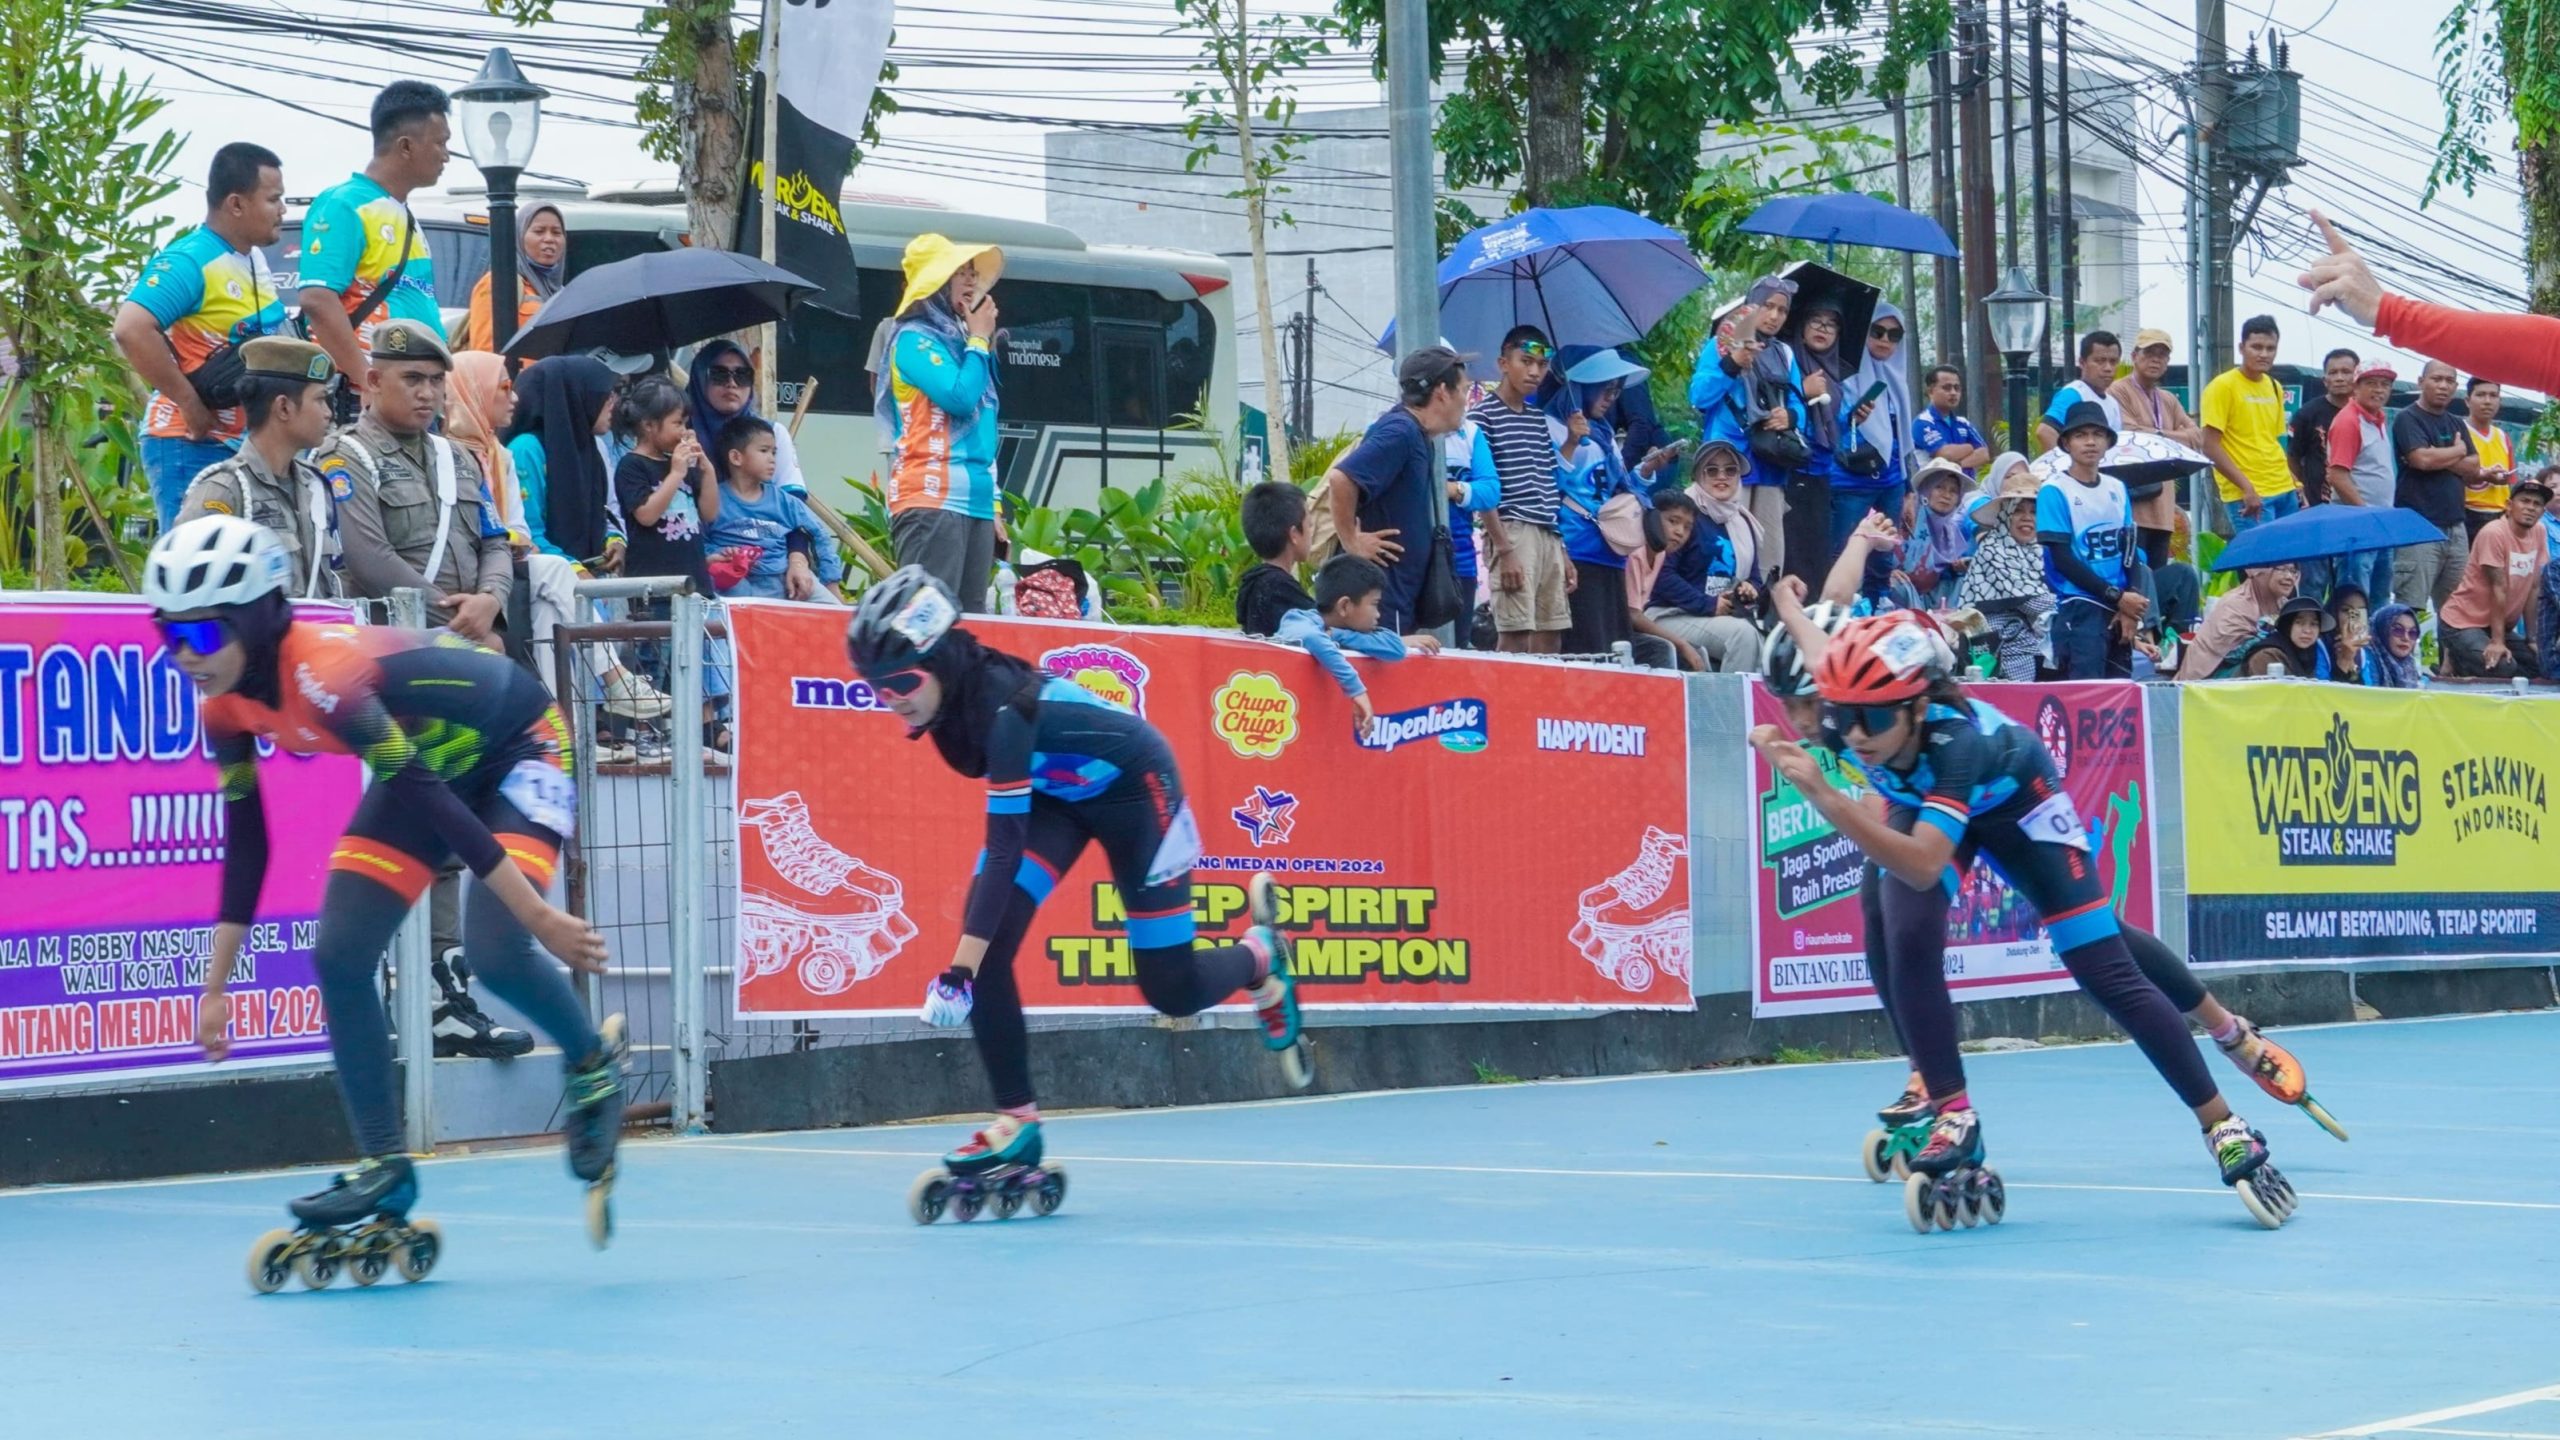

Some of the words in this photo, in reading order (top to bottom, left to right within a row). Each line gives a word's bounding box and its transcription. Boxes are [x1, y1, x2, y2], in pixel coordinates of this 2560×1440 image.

[800, 211, 835, 236] SHAKE
[1225, 690, 1288, 717] Chupa
[1222, 711, 1285, 746] Chups
[1362, 700, 1479, 753] Alpenliebe
[1536, 717, 1647, 757] HAPPYDENT
[2442, 756, 2548, 813] STEAKNYA
[2454, 805, 2541, 844] INDONESIA
[2282, 828, 2333, 856] STEAK
[2332, 828, 2344, 856] &
[2345, 828, 2393, 856] SHAKE
[1225, 857, 1287, 871] MEDAN
[1291, 858, 1336, 872] OPEN
[1340, 860, 1385, 874] 2024
[1782, 853, 1811, 878] Jaga
[1792, 879, 1820, 907] Raih
[2265, 911, 2337, 939] SELAMAT
[2340, 910, 2434, 938] BERTANDING,
[2437, 910, 2477, 935] TETAP
[2480, 909, 2537, 934] SPORTIF!
[37, 936, 62, 966] M.
[68, 931, 134, 964] BOBBY
[61, 960, 115, 994] WALI
[122, 957, 177, 990] KOTA
[1774, 959, 1838, 987] BINTANG
[99, 997, 194, 1052] MEDAN
